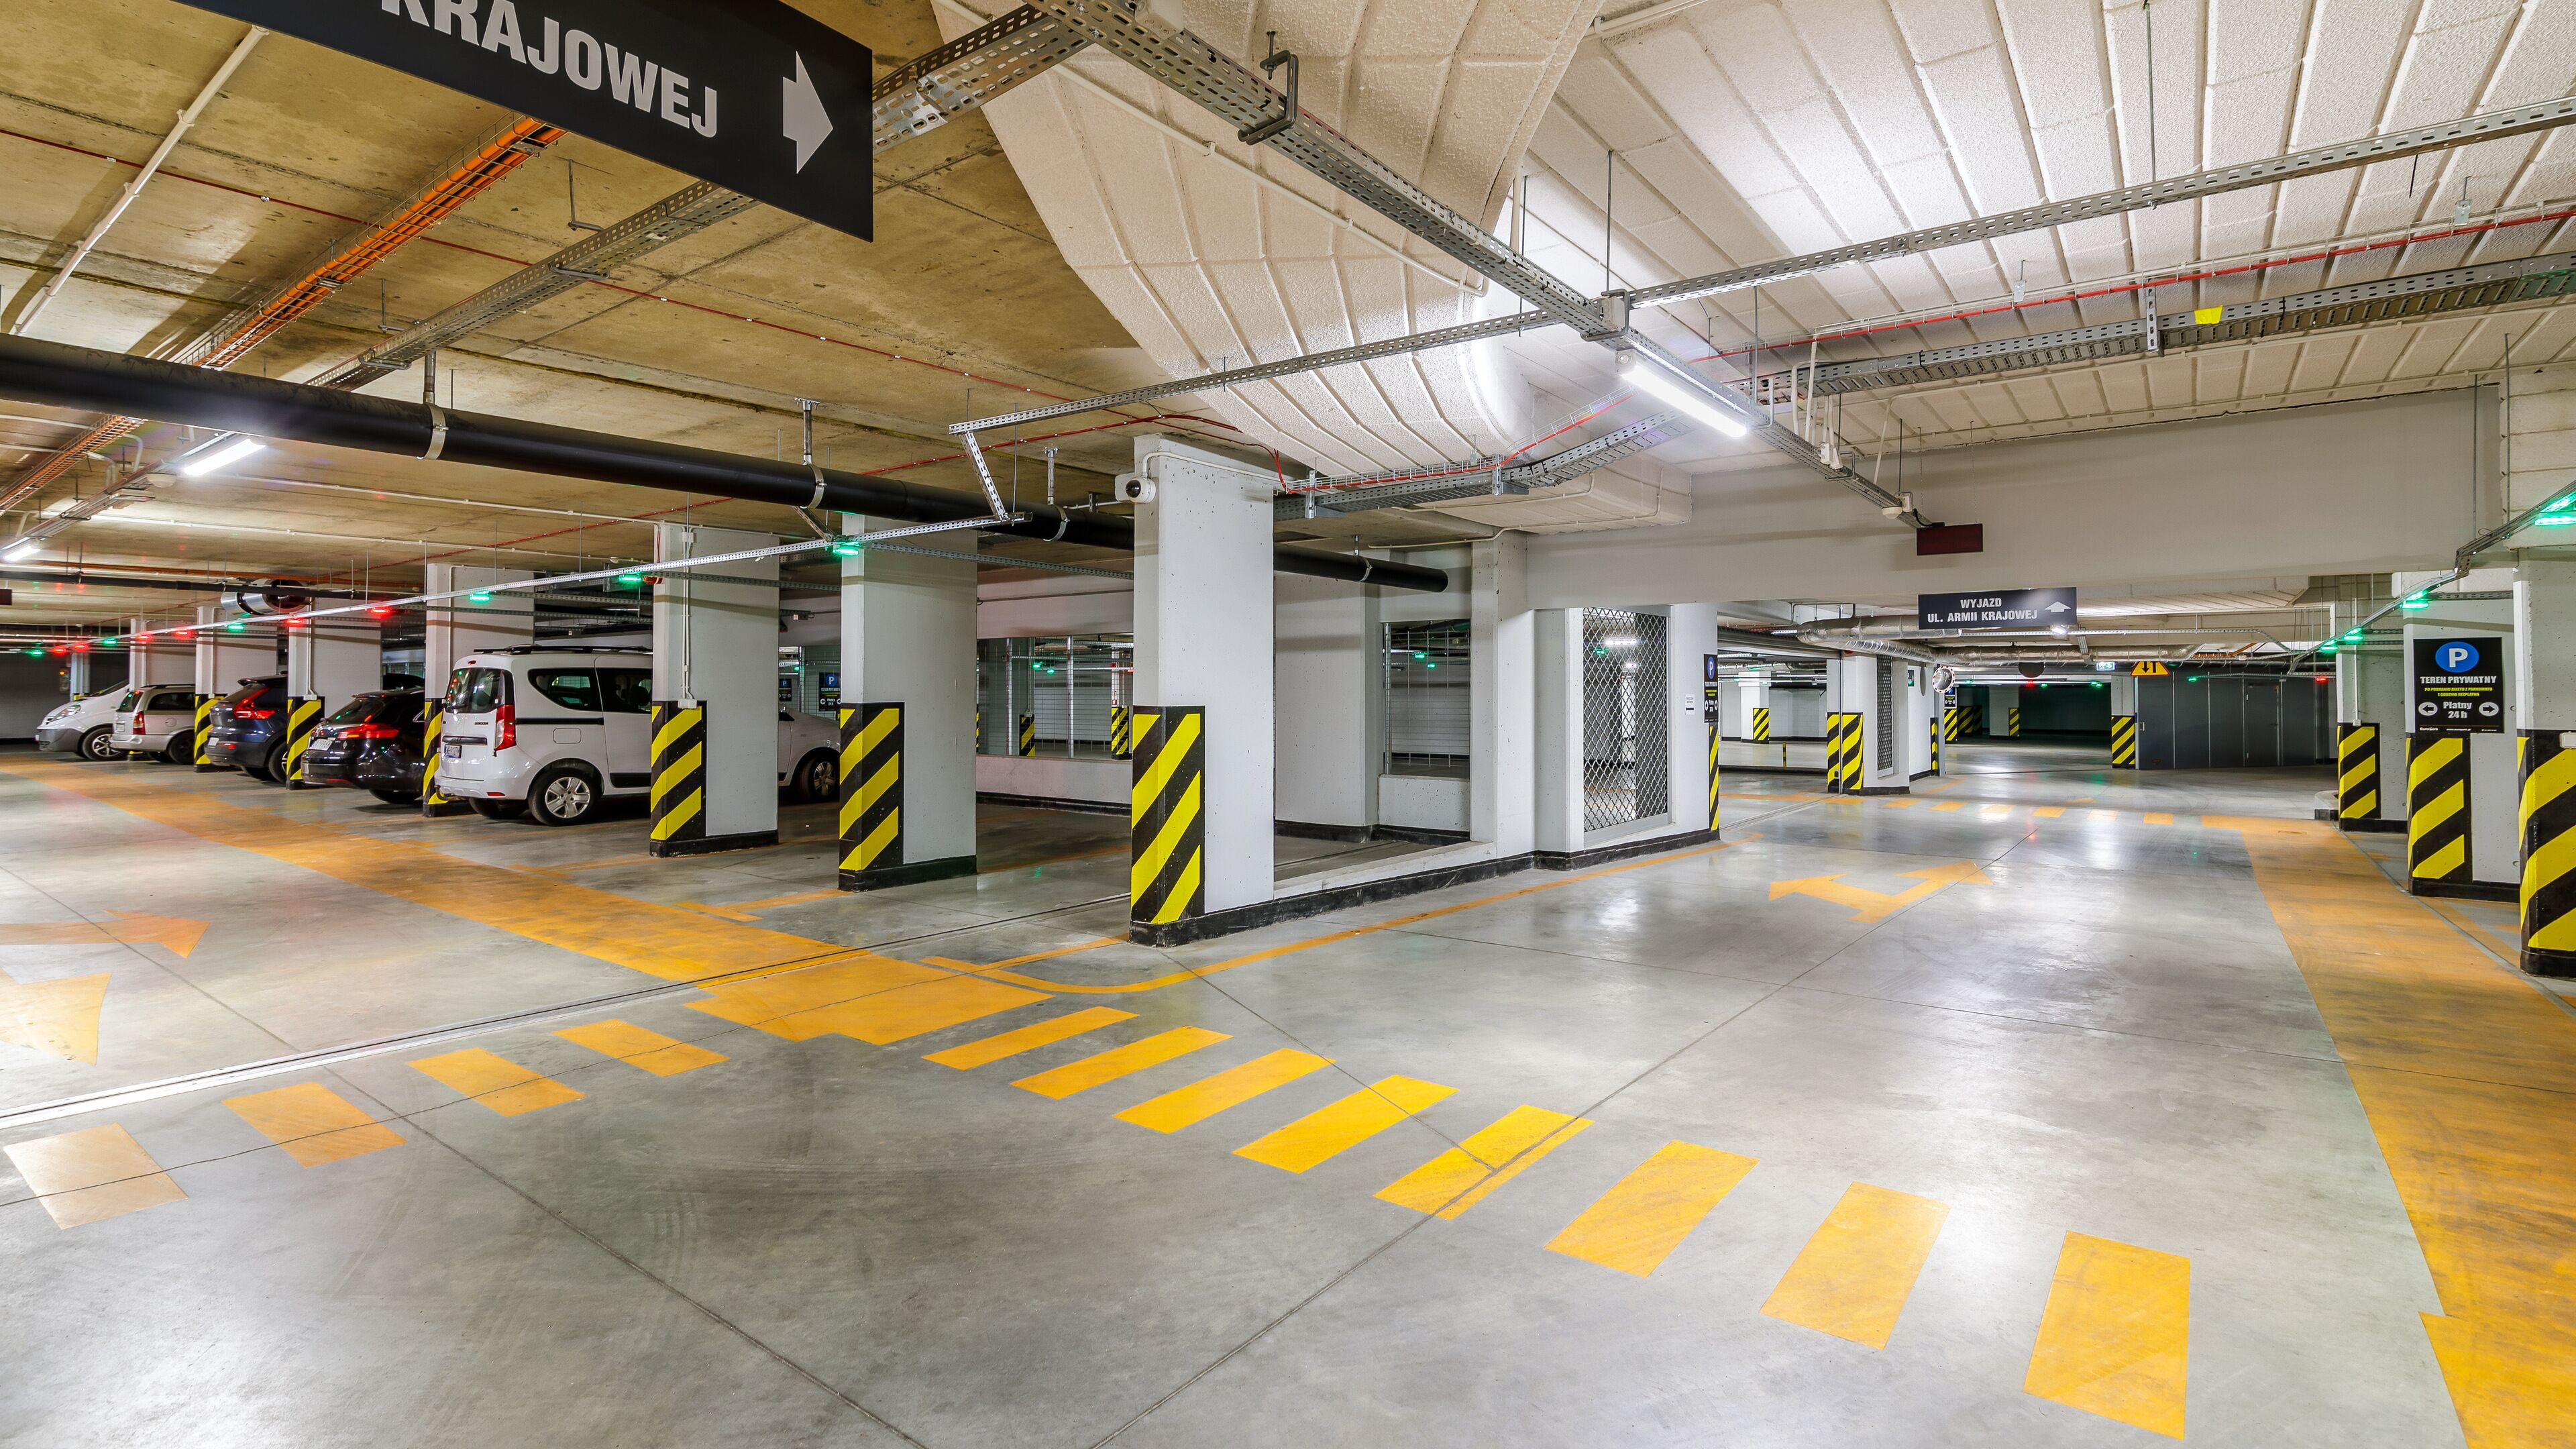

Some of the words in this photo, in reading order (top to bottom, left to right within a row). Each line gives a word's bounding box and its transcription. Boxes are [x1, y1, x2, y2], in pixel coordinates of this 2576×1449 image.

[1960, 598, 2002, 608] WYJAZD
[1927, 613, 1943, 623] UL.
[1947, 612, 1978, 622] ARMII
[1982, 610, 2037, 621] KRAJOWEJ
[2449, 648, 2468, 667] P
[1709, 661, 1713, 676] P
[828, 676, 835, 685] P
[2448, 676, 2497, 684] PRYWATNY
[2448, 710, 2460, 718] 24
[2461, 710, 2467, 718] h
